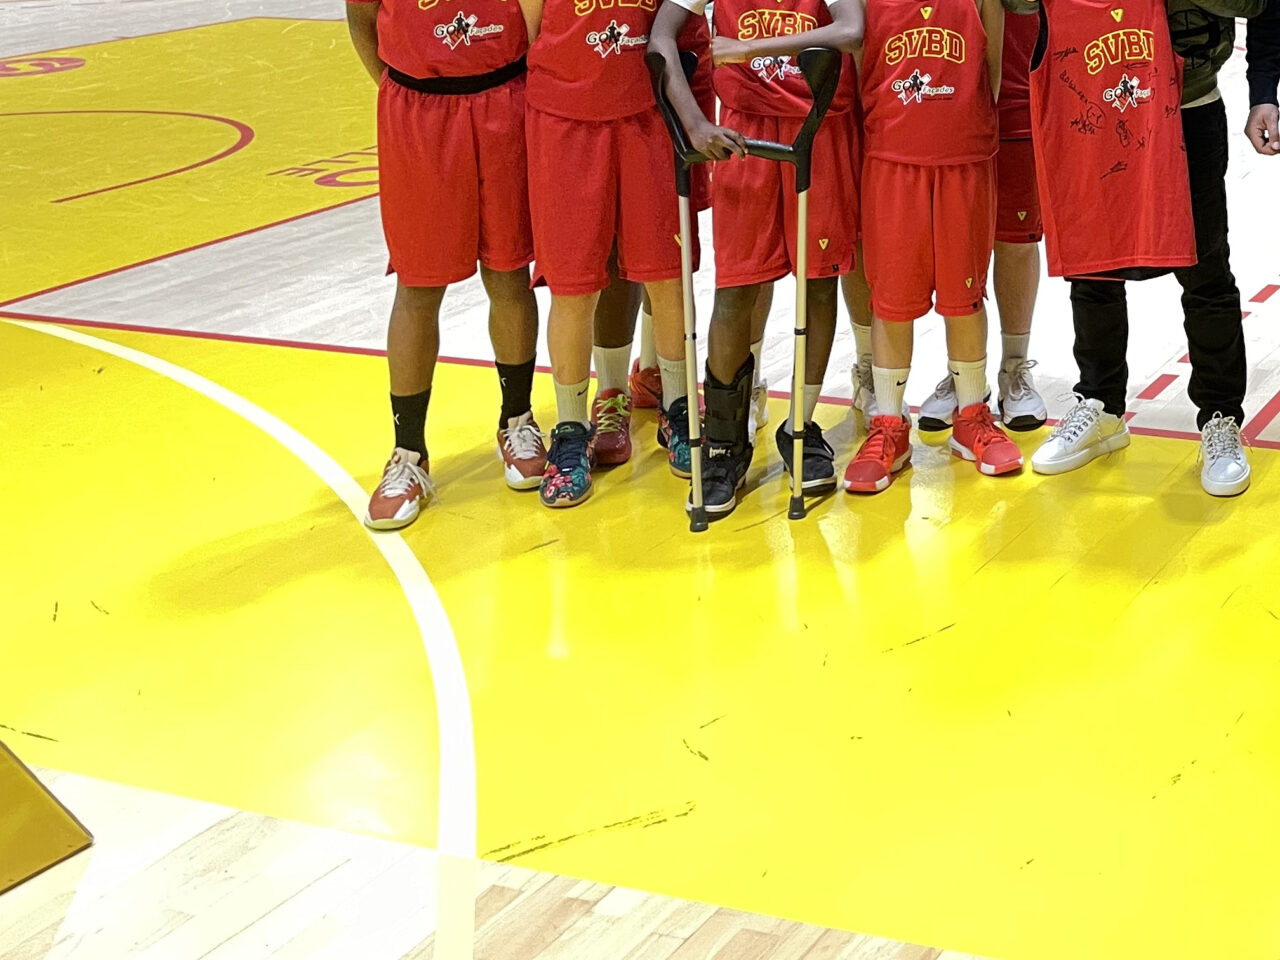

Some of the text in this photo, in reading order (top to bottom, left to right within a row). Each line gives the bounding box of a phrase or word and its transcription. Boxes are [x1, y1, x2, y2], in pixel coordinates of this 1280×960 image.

[470, 22, 504, 36] Façades
[738, 8, 819, 42] SVBD
[885, 26, 966, 66] SVBD
[922, 84, 955, 97] Façades
